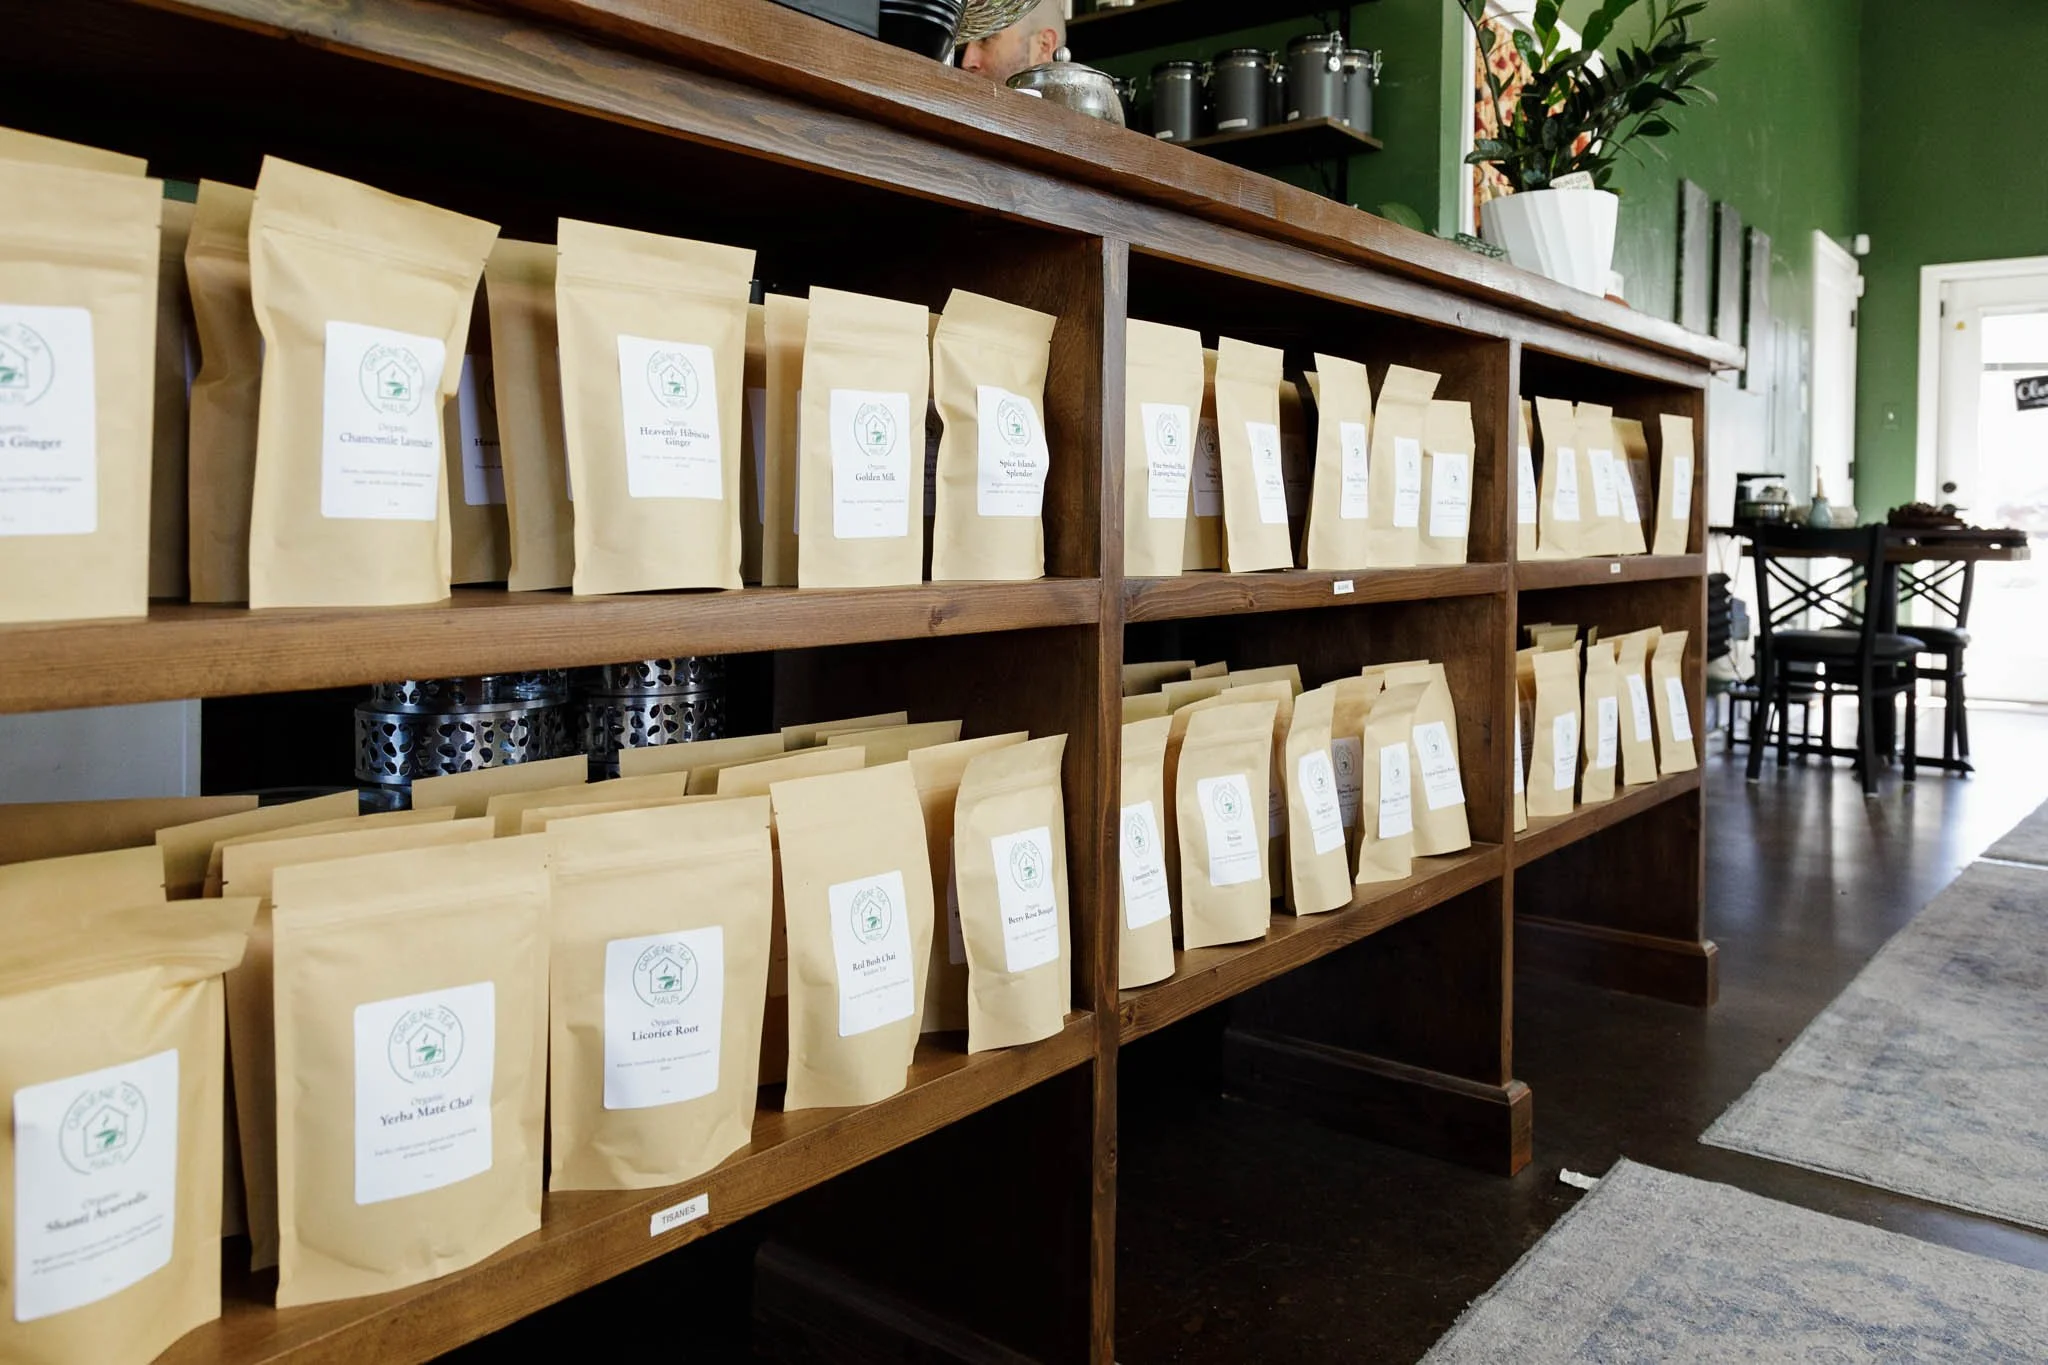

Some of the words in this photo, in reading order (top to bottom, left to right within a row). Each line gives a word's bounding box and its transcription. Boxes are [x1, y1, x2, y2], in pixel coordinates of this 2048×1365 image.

[402, 353, 418, 373] TEA
[379, 423, 408, 434] Organic
[640, 426, 678, 438] Heavenly
[680, 428, 710, 440] Hibiscus
[10, 436, 62, 450] Ginger
[340, 432, 398, 446] Chamomile
[664, 438, 691, 448] Ginger
[1000, 460, 1016, 468] Spice
[856, 472, 880, 482] Golden
[882, 472, 896, 481] Milk
[1006, 469, 1032, 478] Splendor
[1008, 916, 1024, 925] Berry
[1025, 912, 1037, 920] Rose
[638, 944, 676, 972] GRUENE
[678, 947, 692, 966] TEA
[852, 959, 865, 972] Red
[866, 956, 881, 967] Bush
[882, 951, 896, 962] Chai
[393, 1008, 434, 1045] GRUENE
[437, 1010, 456, 1032] TEA
[651, 1018, 680, 1028] Organic
[632, 1028, 673, 1042] Licorice
[675, 1024, 700, 1036] Root
[410, 1093, 446, 1106] Organic
[66, 1084, 116, 1131] GRUENE
[120, 1086, 139, 1109] TEA
[380, 1110, 414, 1127] Yerba
[449, 1095, 473, 1111] Chai
[662, 1204, 696, 1224] TISANES
[46, 1211, 90, 1233] Shanti
